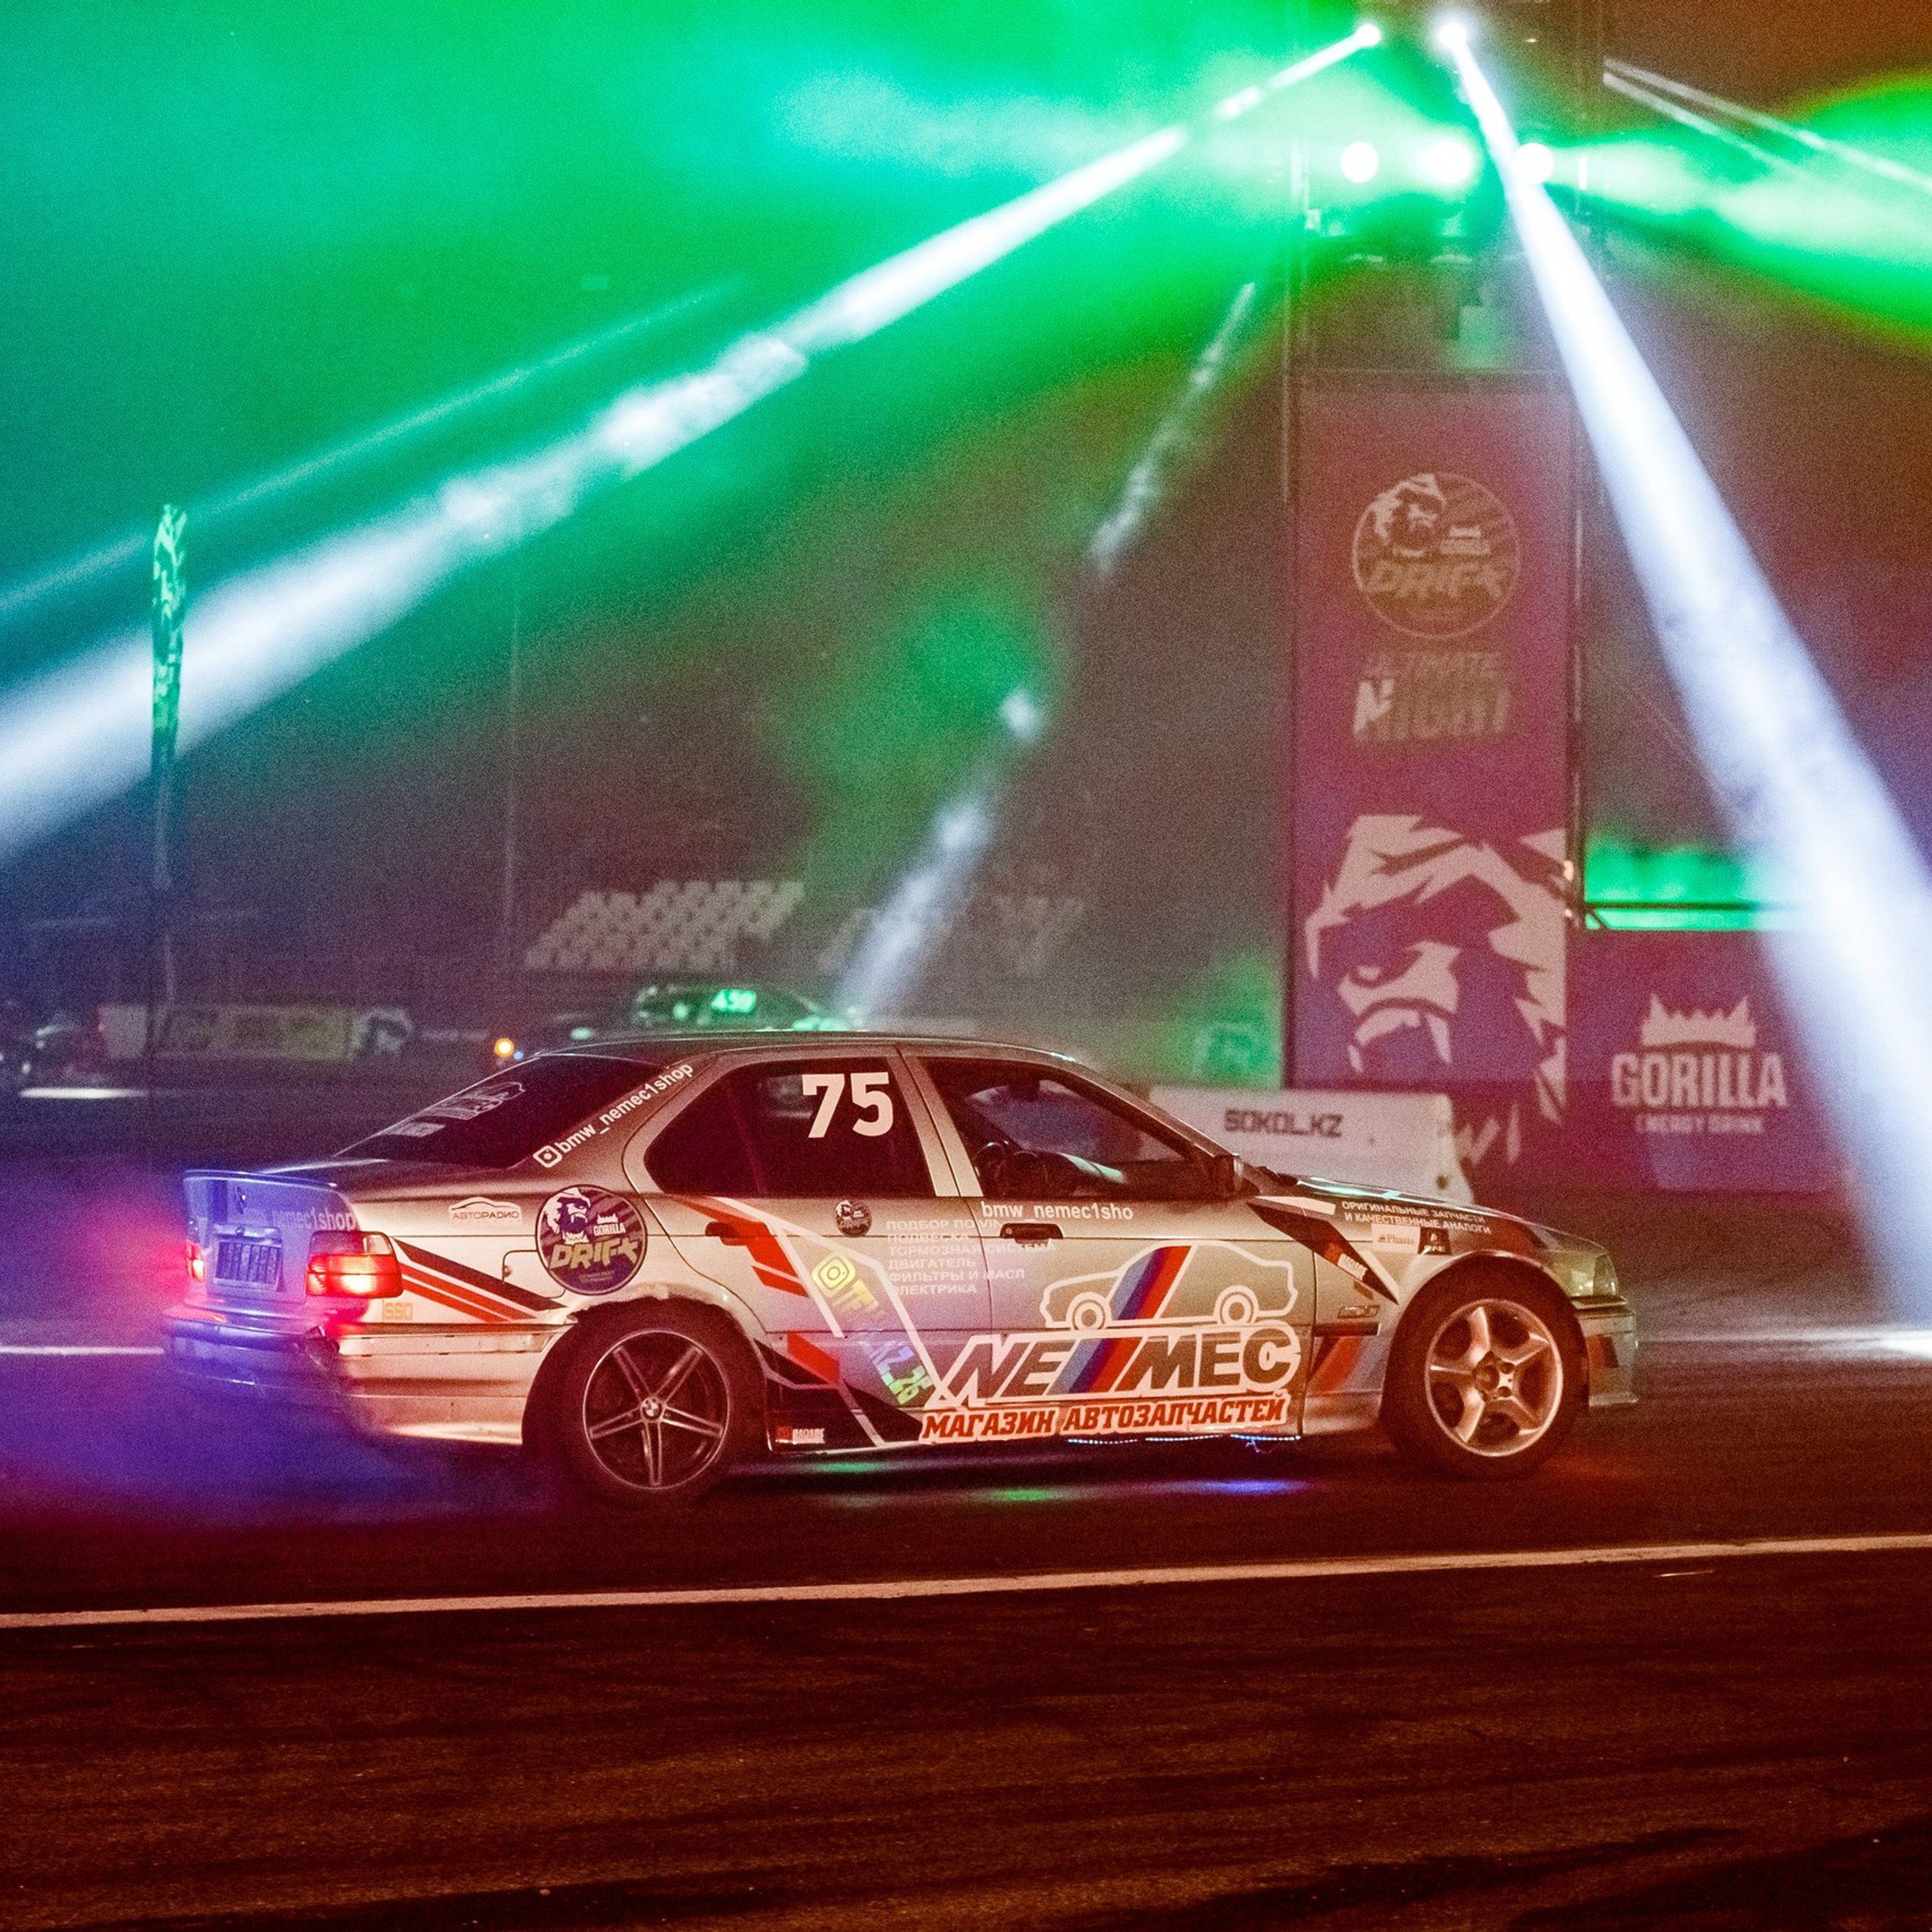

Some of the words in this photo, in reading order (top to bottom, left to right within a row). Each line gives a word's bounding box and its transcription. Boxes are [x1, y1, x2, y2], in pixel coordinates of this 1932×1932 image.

[801, 1072, 894, 1139] 75
[1611, 1053, 1789, 1107] GORILLA
[555, 1064, 694, 1153] bmw_nemec1shop
[549, 1236, 639, 1269] DRIFT
[593, 1223, 626, 1236] GORILLA
[927, 1322, 1300, 1406] NEMEC
[925, 1409, 1056, 1438] МАГАЗИН
[1063, 1392, 1287, 1432] АВТОЗАПЧАСТЕЙ
